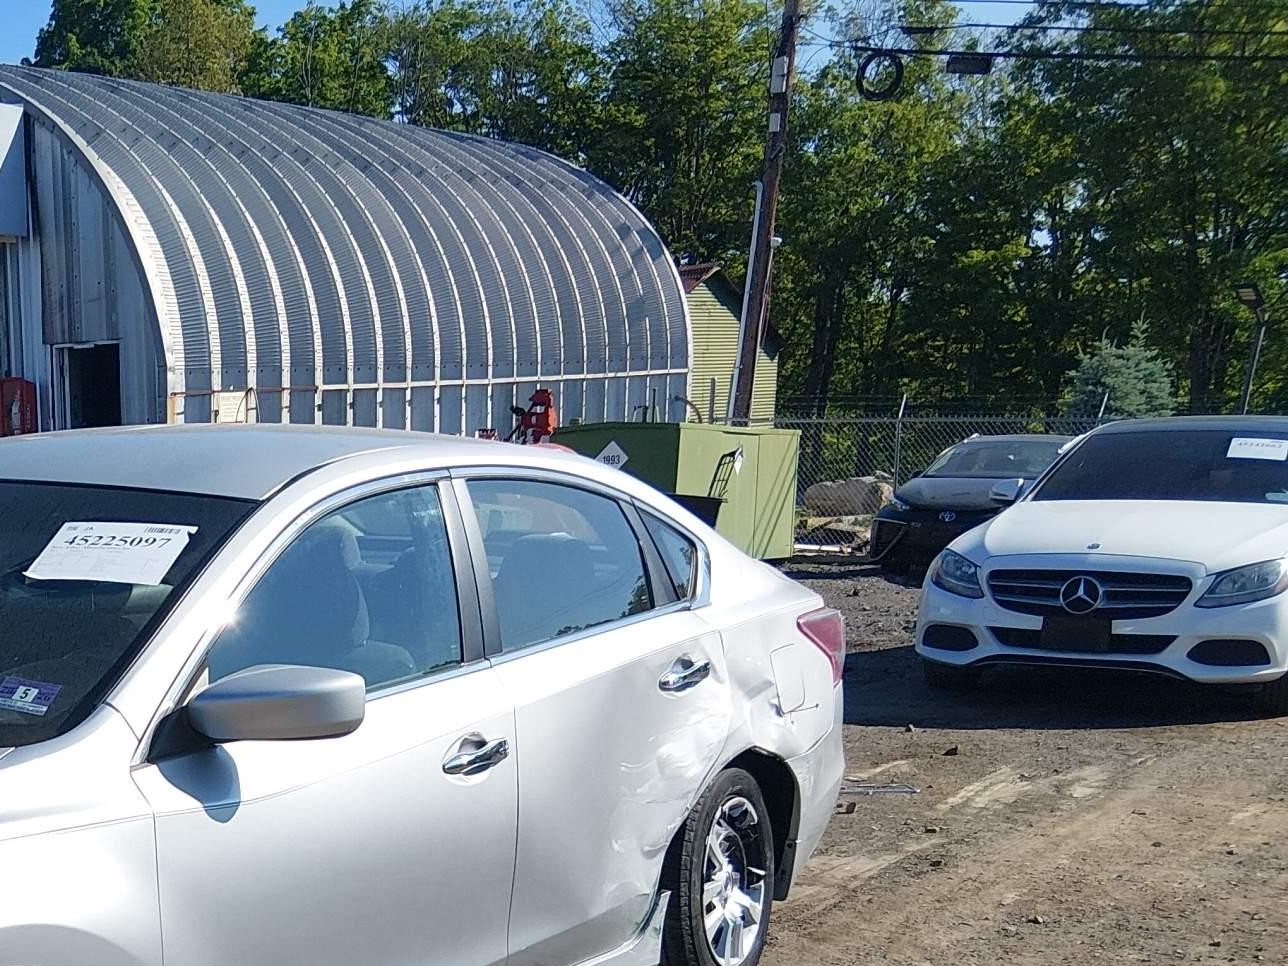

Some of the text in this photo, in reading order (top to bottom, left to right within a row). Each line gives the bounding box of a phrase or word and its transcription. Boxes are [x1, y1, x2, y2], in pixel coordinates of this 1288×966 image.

[602, 454, 621, 465] 1993
[64, 534, 172, 549] 45225097
[19, 688, 32, 699] 5
